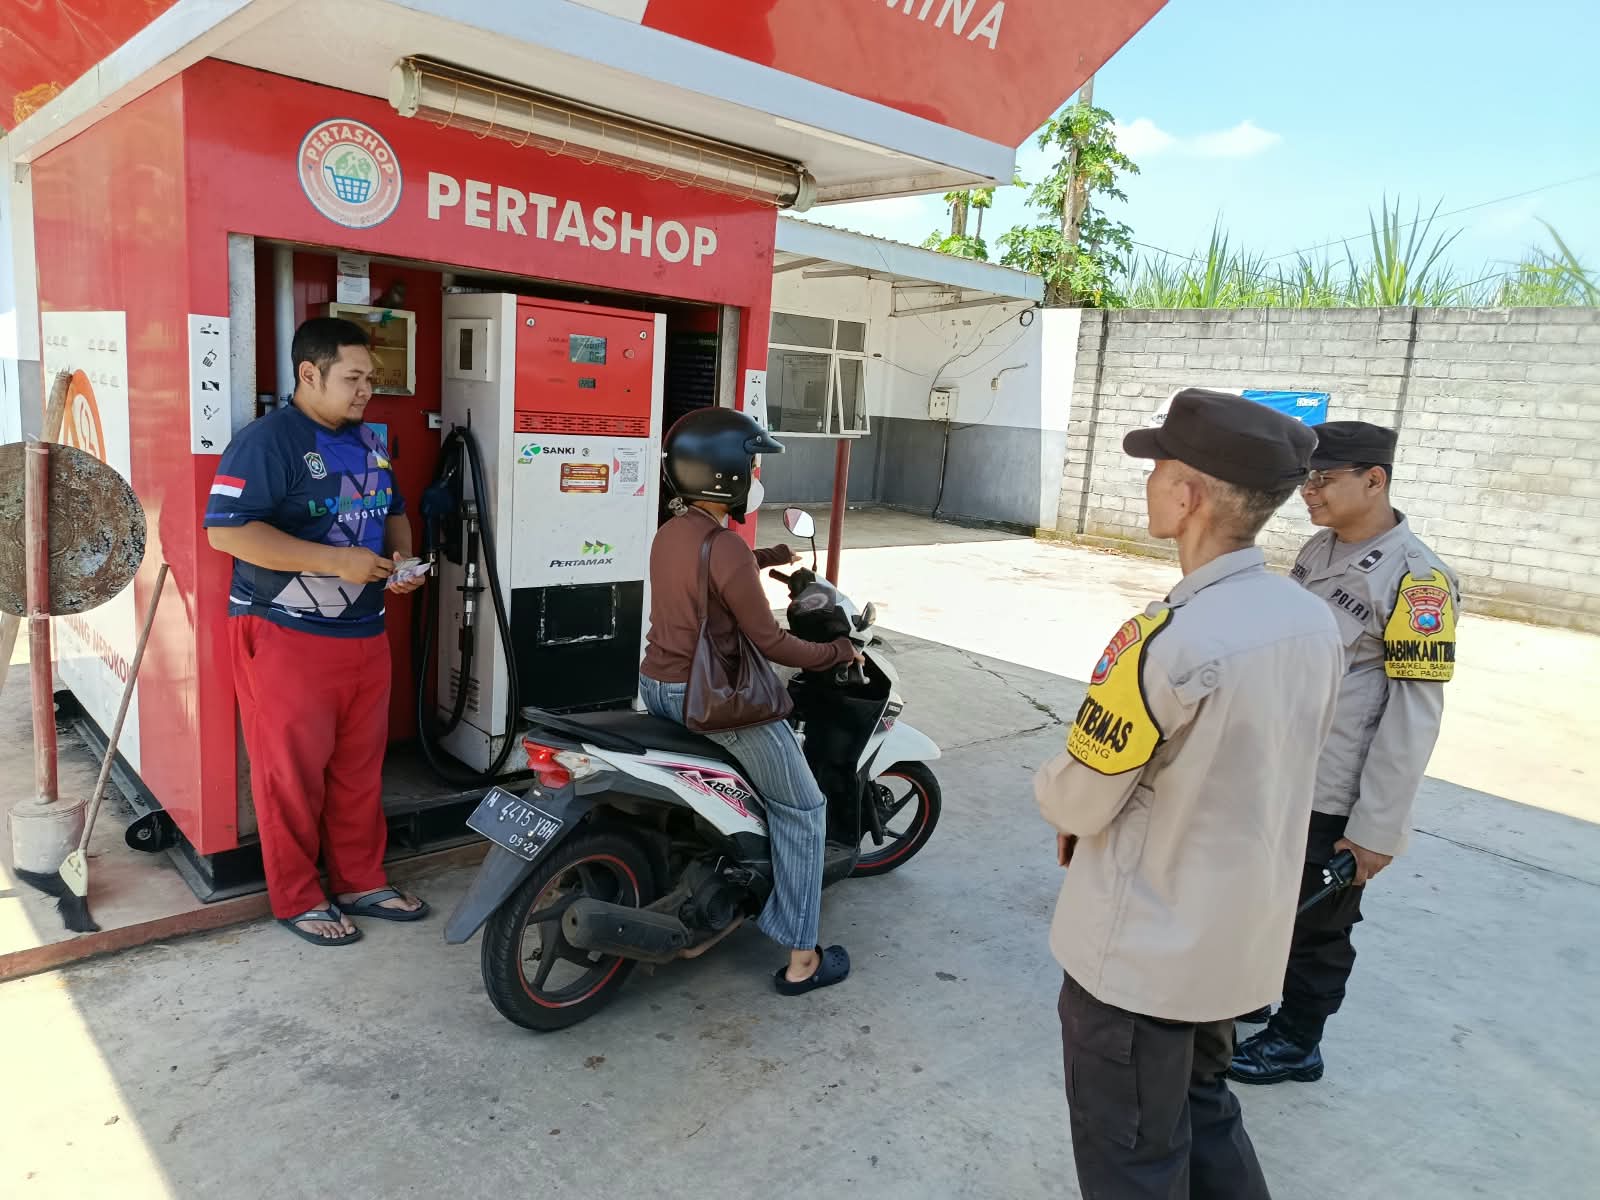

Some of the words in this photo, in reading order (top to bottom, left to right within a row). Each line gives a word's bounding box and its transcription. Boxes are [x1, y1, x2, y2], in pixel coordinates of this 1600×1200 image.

[306, 125, 394, 175] PERTASHOP
[427, 172, 718, 267] PERTASHOP
[542, 446, 576, 455] SANKI
[338, 507, 389, 523] EKSOTIK
[549, 558, 614, 568] PERTAMAX
[1331, 588, 1370, 621] POLRI
[486, 791, 501, 808] N
[501, 801, 535, 827] 4415
[533, 816, 559, 840] YBH
